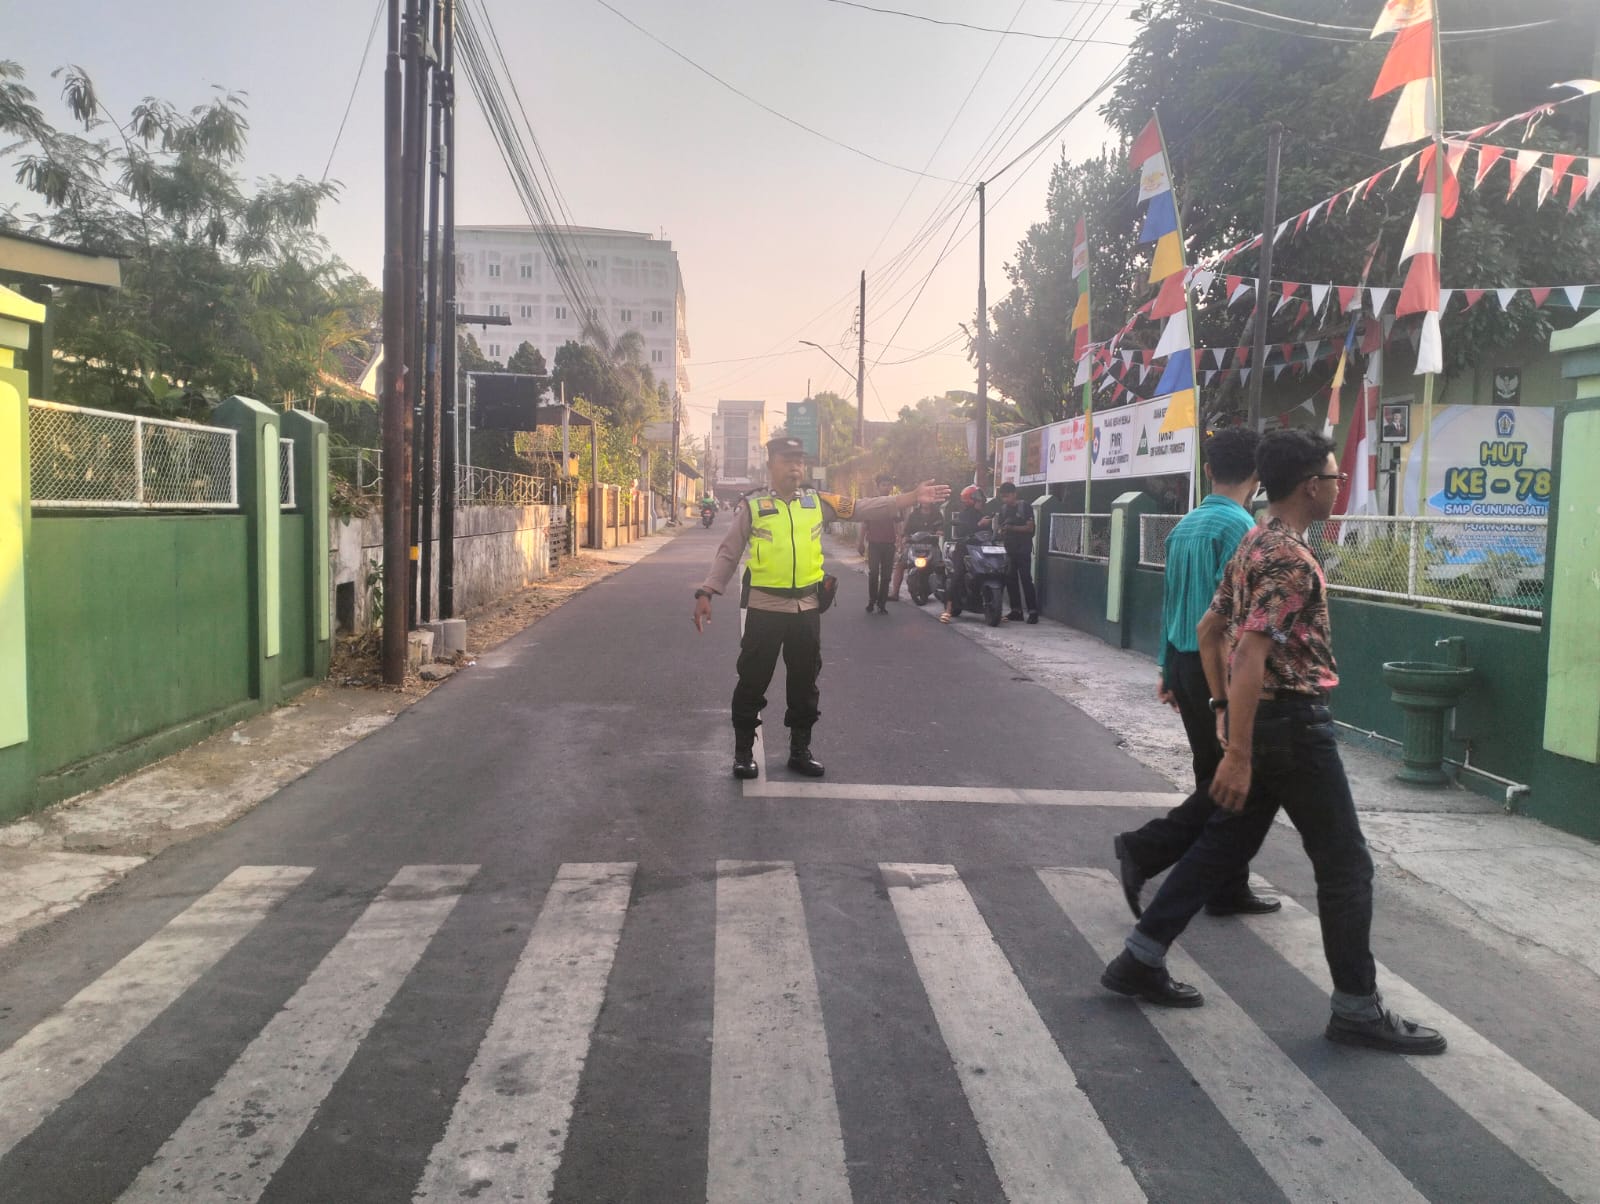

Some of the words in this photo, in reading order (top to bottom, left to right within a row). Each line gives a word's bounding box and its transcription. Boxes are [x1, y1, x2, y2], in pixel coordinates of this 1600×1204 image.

[1480, 442, 1528, 465] HUT
[1446, 468, 1486, 499] KE
[1515, 469, 1551, 500] 78
[1444, 504, 1470, 515] SMP
[1473, 504, 1546, 516] GUNUNGJATI
